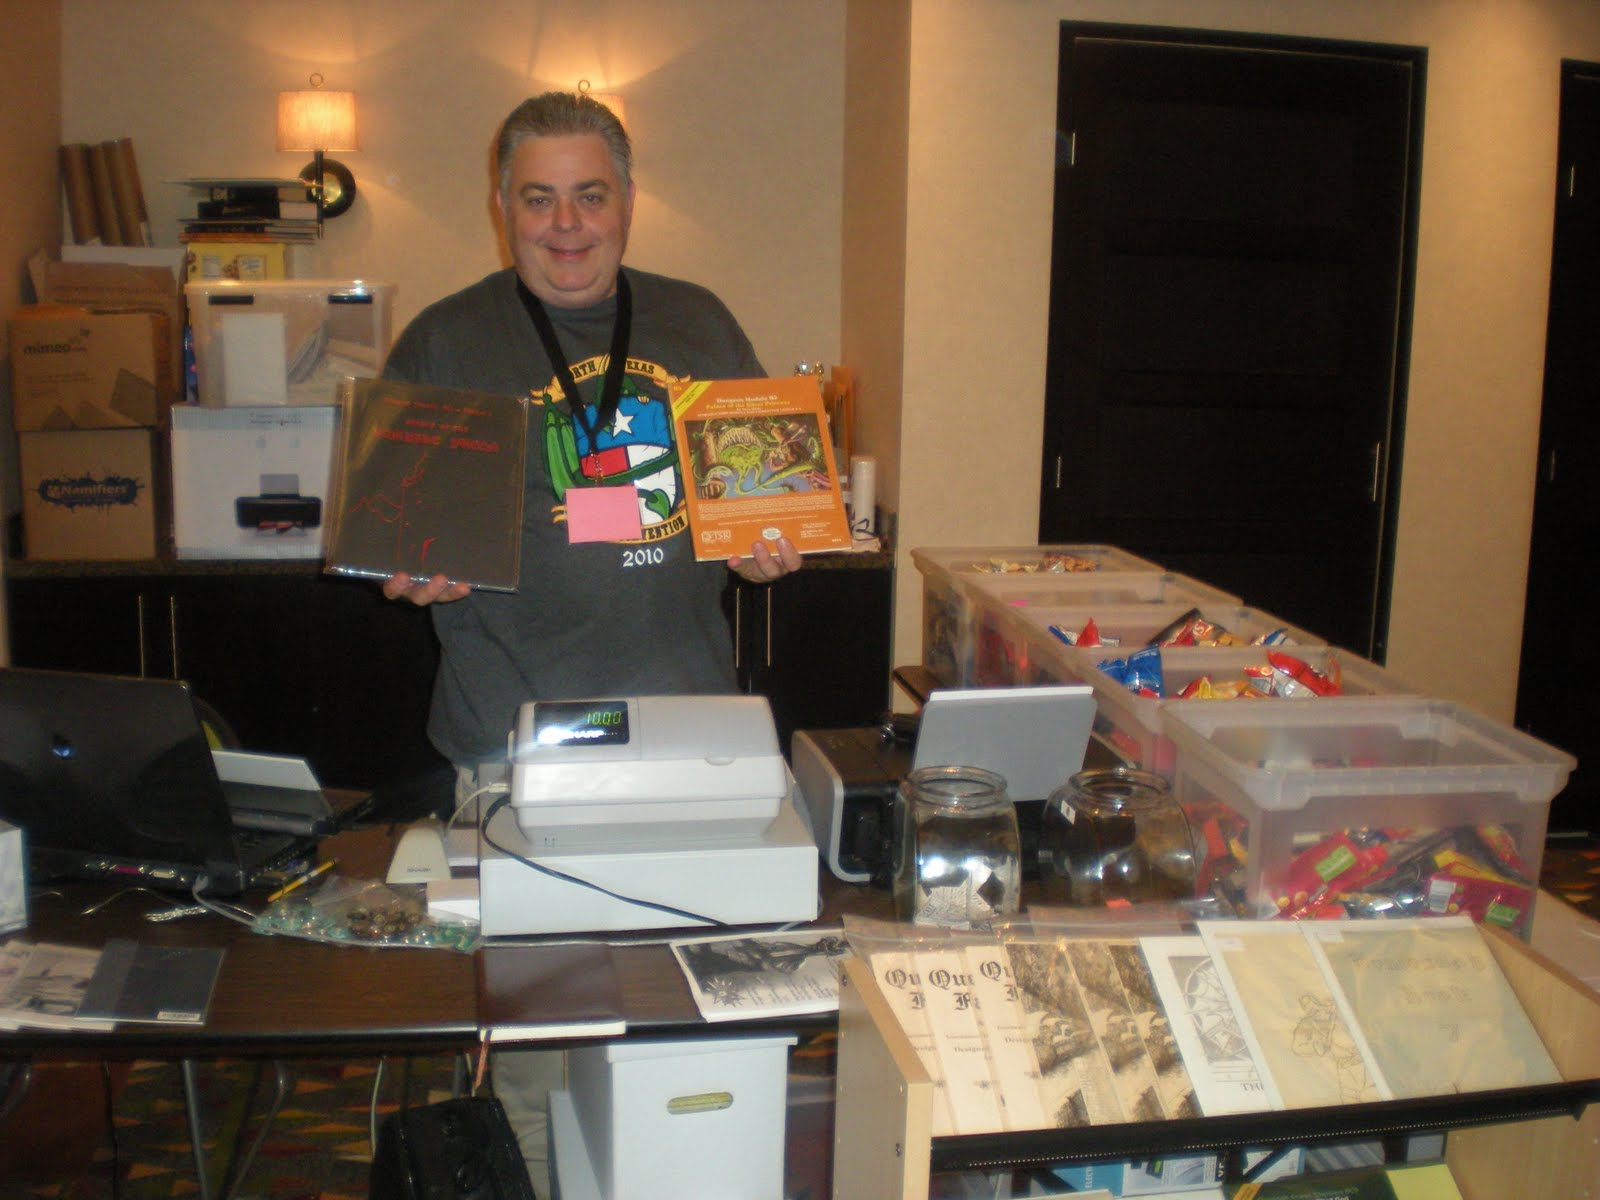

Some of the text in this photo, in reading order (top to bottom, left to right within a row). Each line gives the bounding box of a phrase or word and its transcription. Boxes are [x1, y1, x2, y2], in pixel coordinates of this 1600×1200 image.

[572, 360, 655, 378] RTH EXAS
[642, 515, 686, 541] VENTION
[622, 547, 664, 568] 2010
[587, 711, 622, 726] 10.00
